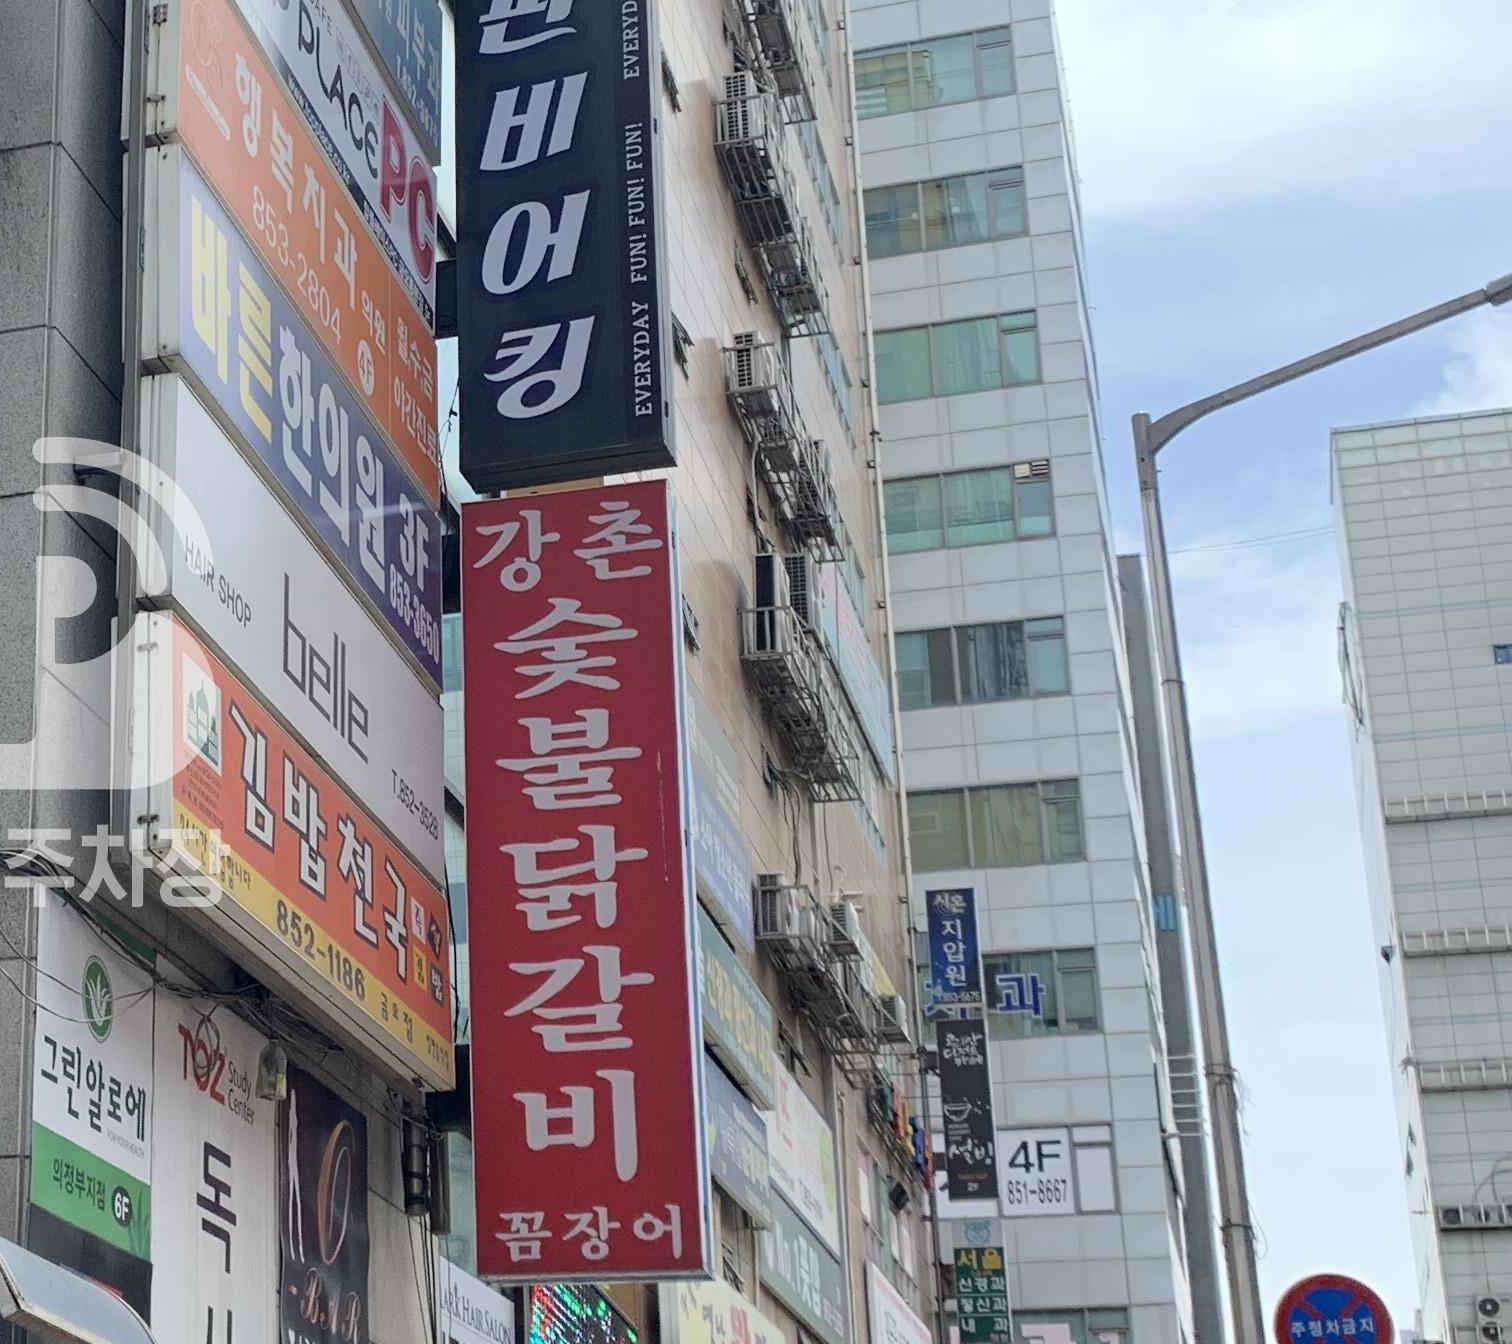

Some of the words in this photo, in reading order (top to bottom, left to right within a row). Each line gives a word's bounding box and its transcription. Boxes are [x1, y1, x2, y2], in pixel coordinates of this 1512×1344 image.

[379, 88, 434, 300] PC
[626, 121, 642, 171] FUN!
[234, 44, 357, 320] 행복치과
[362, 286, 385, 358] 의원
[627, 174, 643, 228] FUN!
[253, 179, 341, 349] 853-2804
[630, 233, 646, 284] FUN!
[634, 299, 652, 418] EVERYDAY
[184, 529, 214, 598] HAIR
[218, 568, 251, 639] SHOP
[399, 487, 428, 601] 3F
[472, 500, 664, 594] 강촌
[389, 561, 439, 669] 853-3650
[282, 567, 369, 768] belle
[229, 693, 410, 987] 김밥천국
[276, 891, 365, 1009] 852-1186
[40, 1035, 147, 1142] 그린알로에
[227, 1093, 255, 1126] Center
[228, 1059, 253, 1099] Study
[52, 1157, 106, 1212] 의정부지점
[114, 1192, 130, 1221] 6F
[1007, 1178, 1068, 1204] 851-8667
[1008, 1140, 1061, 1173] 4F
[496, 1205, 684, 1264] 꼼장어
